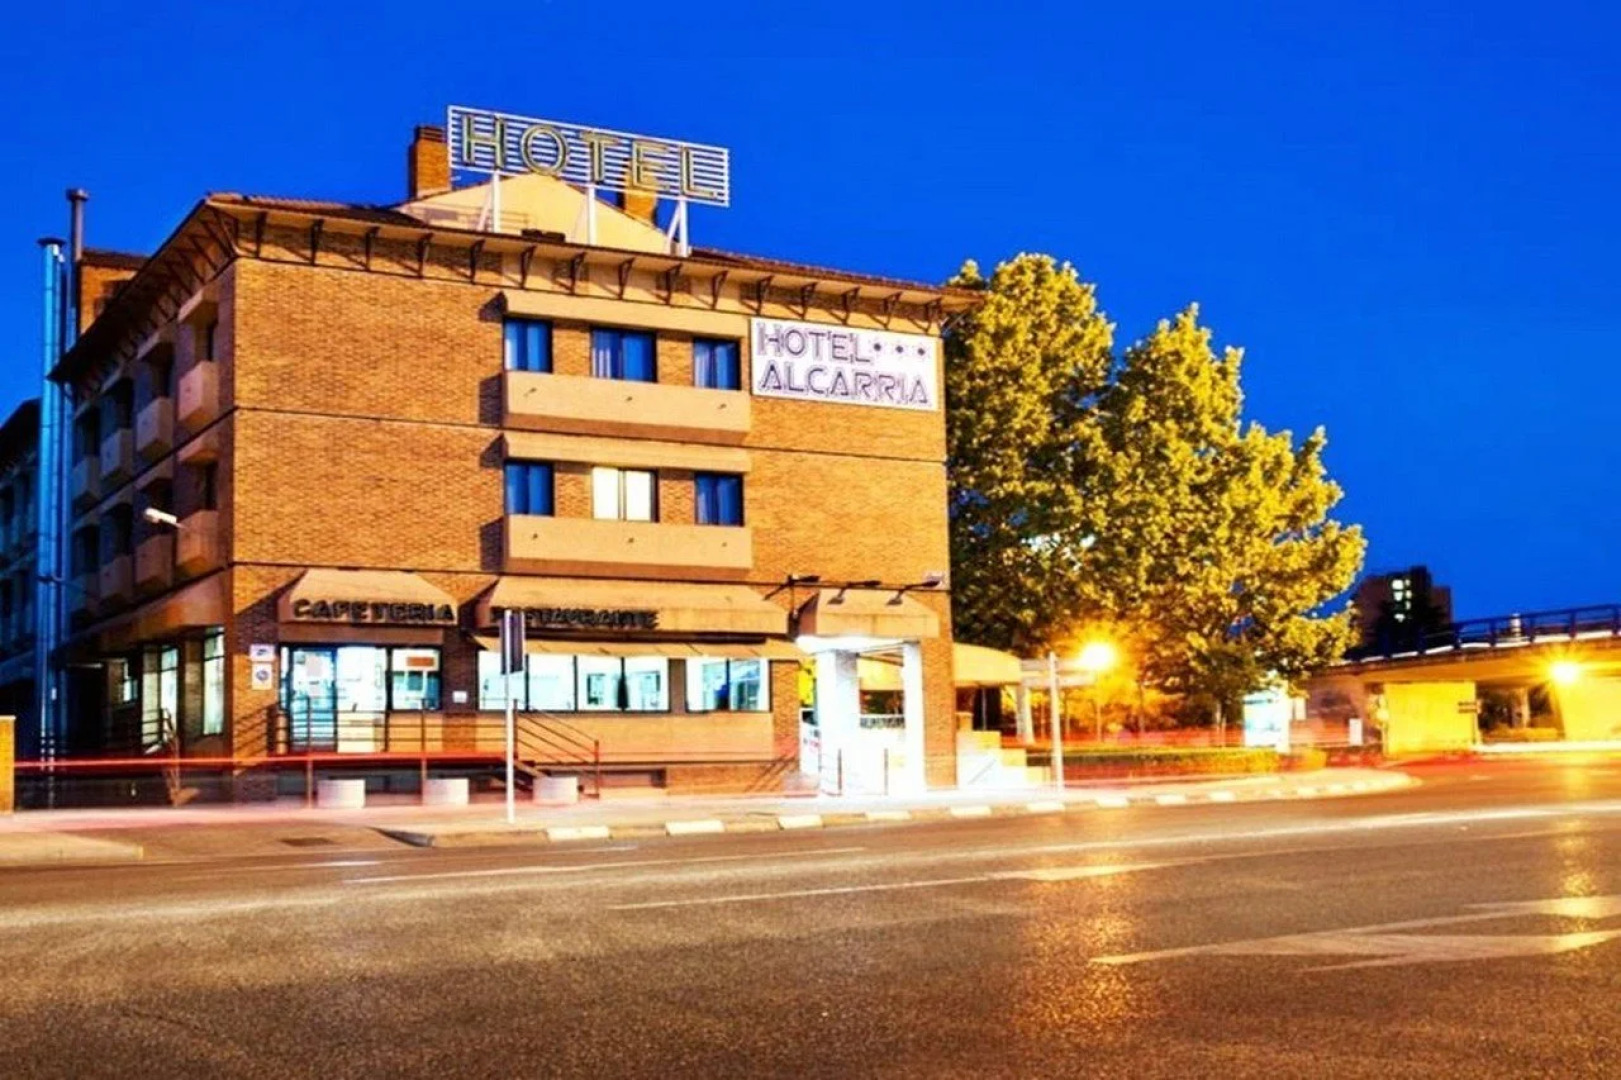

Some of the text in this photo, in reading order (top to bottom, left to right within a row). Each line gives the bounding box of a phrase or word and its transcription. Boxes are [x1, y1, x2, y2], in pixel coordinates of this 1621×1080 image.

[461, 113, 718, 199] HOTEL
[756, 321, 874, 365] HOTEL
[758, 359, 932, 409] ALCARRIA
[293, 599, 455, 622] CAFETERIA
